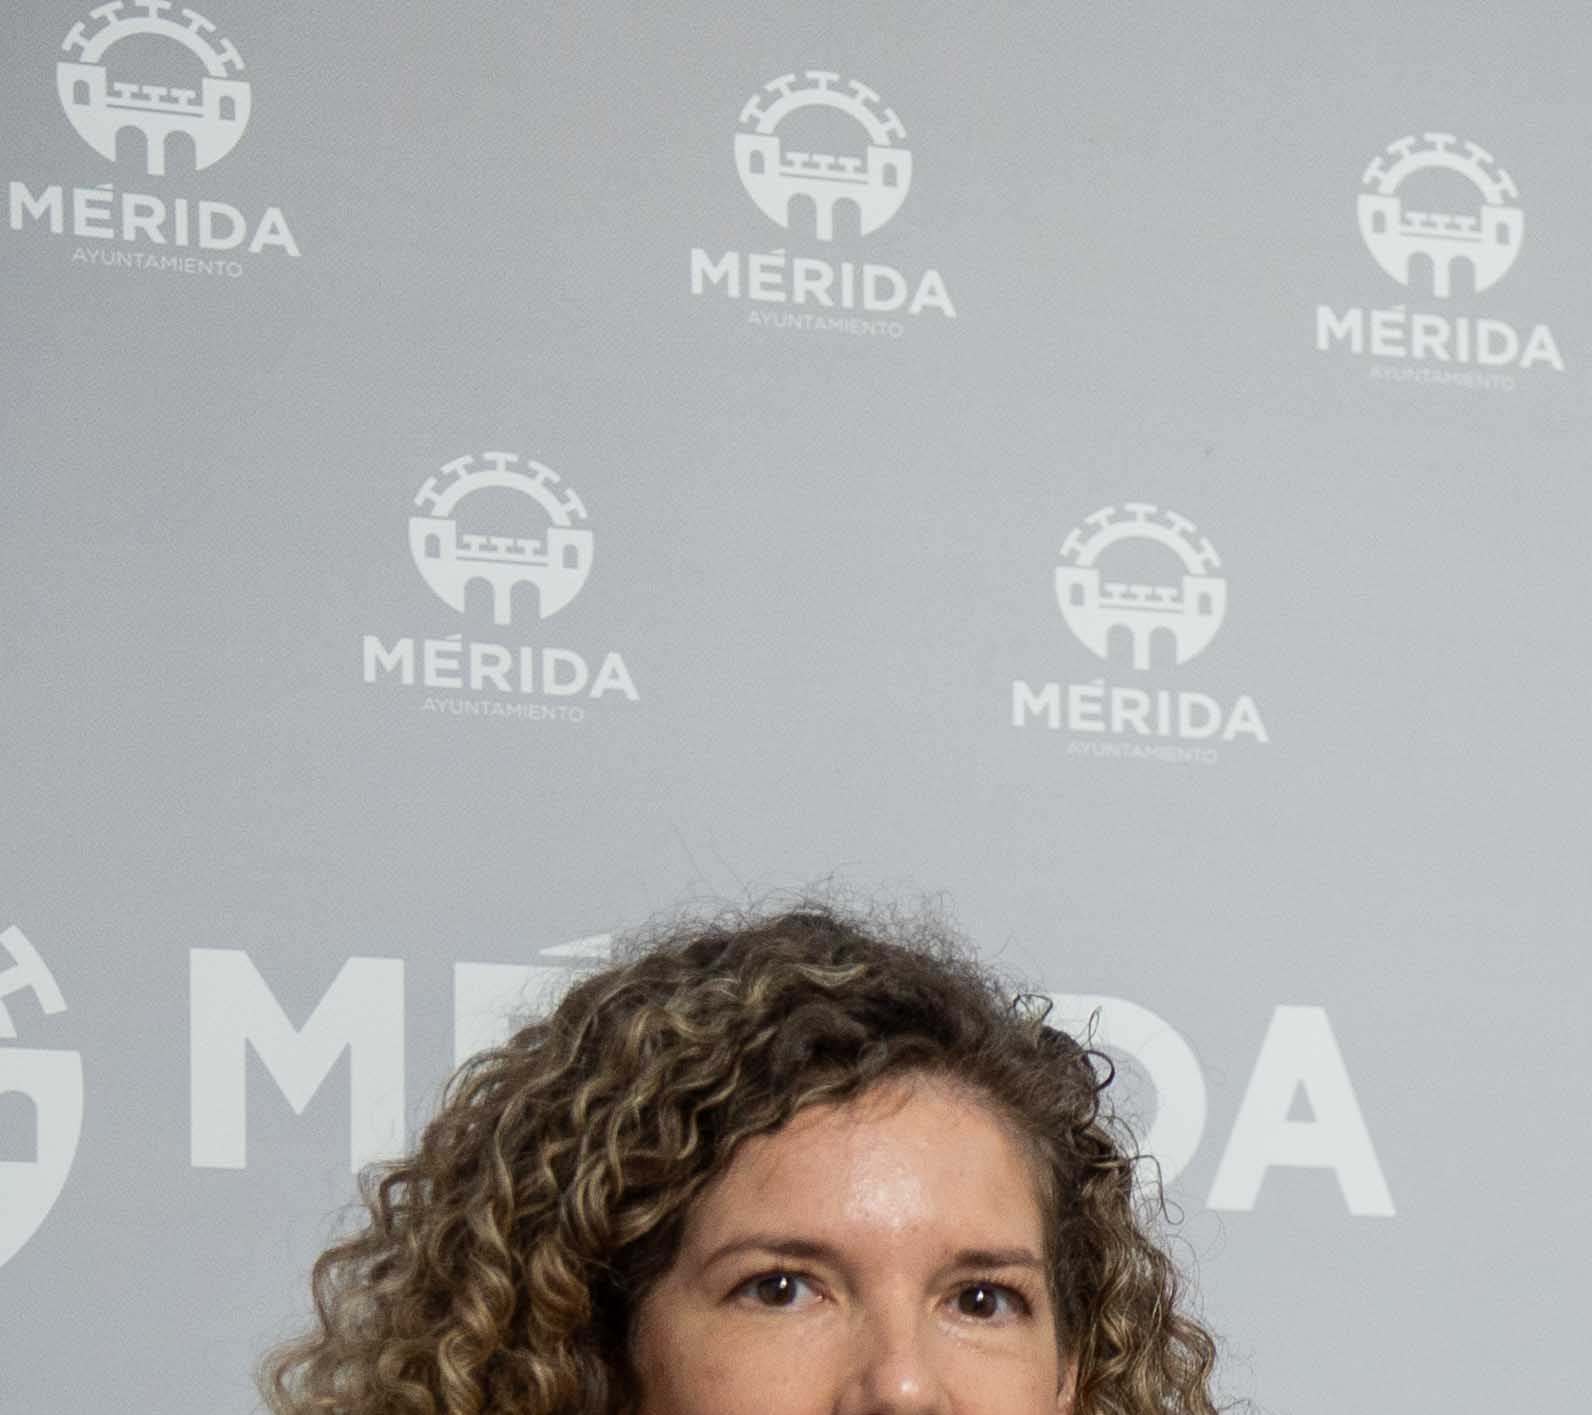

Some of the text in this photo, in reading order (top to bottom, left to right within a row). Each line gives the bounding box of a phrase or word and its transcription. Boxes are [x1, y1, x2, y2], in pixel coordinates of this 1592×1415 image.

[11, 183, 300, 257] MÉRIDA
[71, 245, 244, 278] AYUNTAMIENTO
[691, 249, 956, 317] MÉRIDA
[746, 309, 905, 338] AYUNTAMIENTO
[1317, 306, 1563, 371] MÉRIDA
[364, 634, 639, 701] MÉRIDA
[421, 696, 585, 723] AYUNTAMIENTO
[1013, 680, 1268, 743] MÉRIDA
